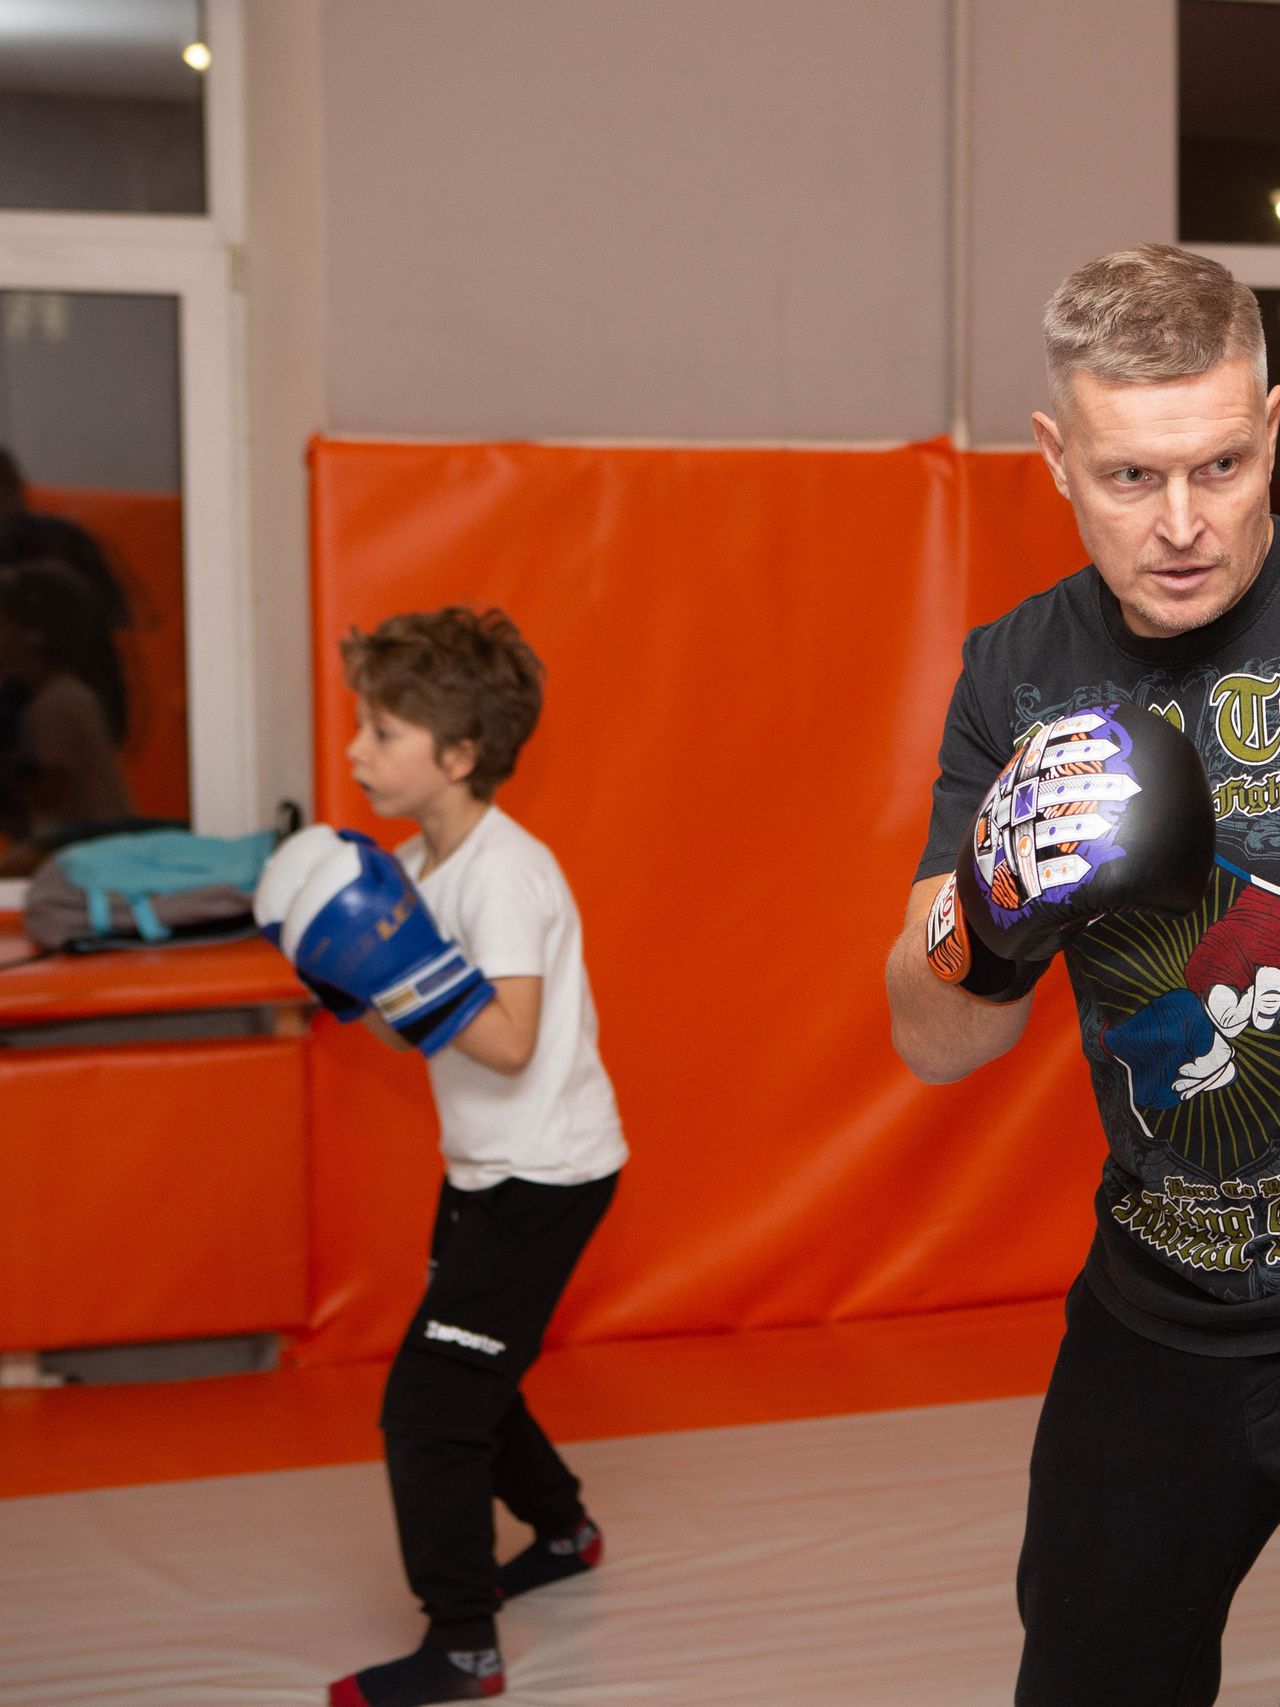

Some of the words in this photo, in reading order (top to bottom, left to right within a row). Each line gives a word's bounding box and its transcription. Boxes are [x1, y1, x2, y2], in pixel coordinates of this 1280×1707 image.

[1164, 1175, 1220, 1200] Born
[1220, 1177, 1257, 1199] To
[1142, 1190, 1255, 1244] King
